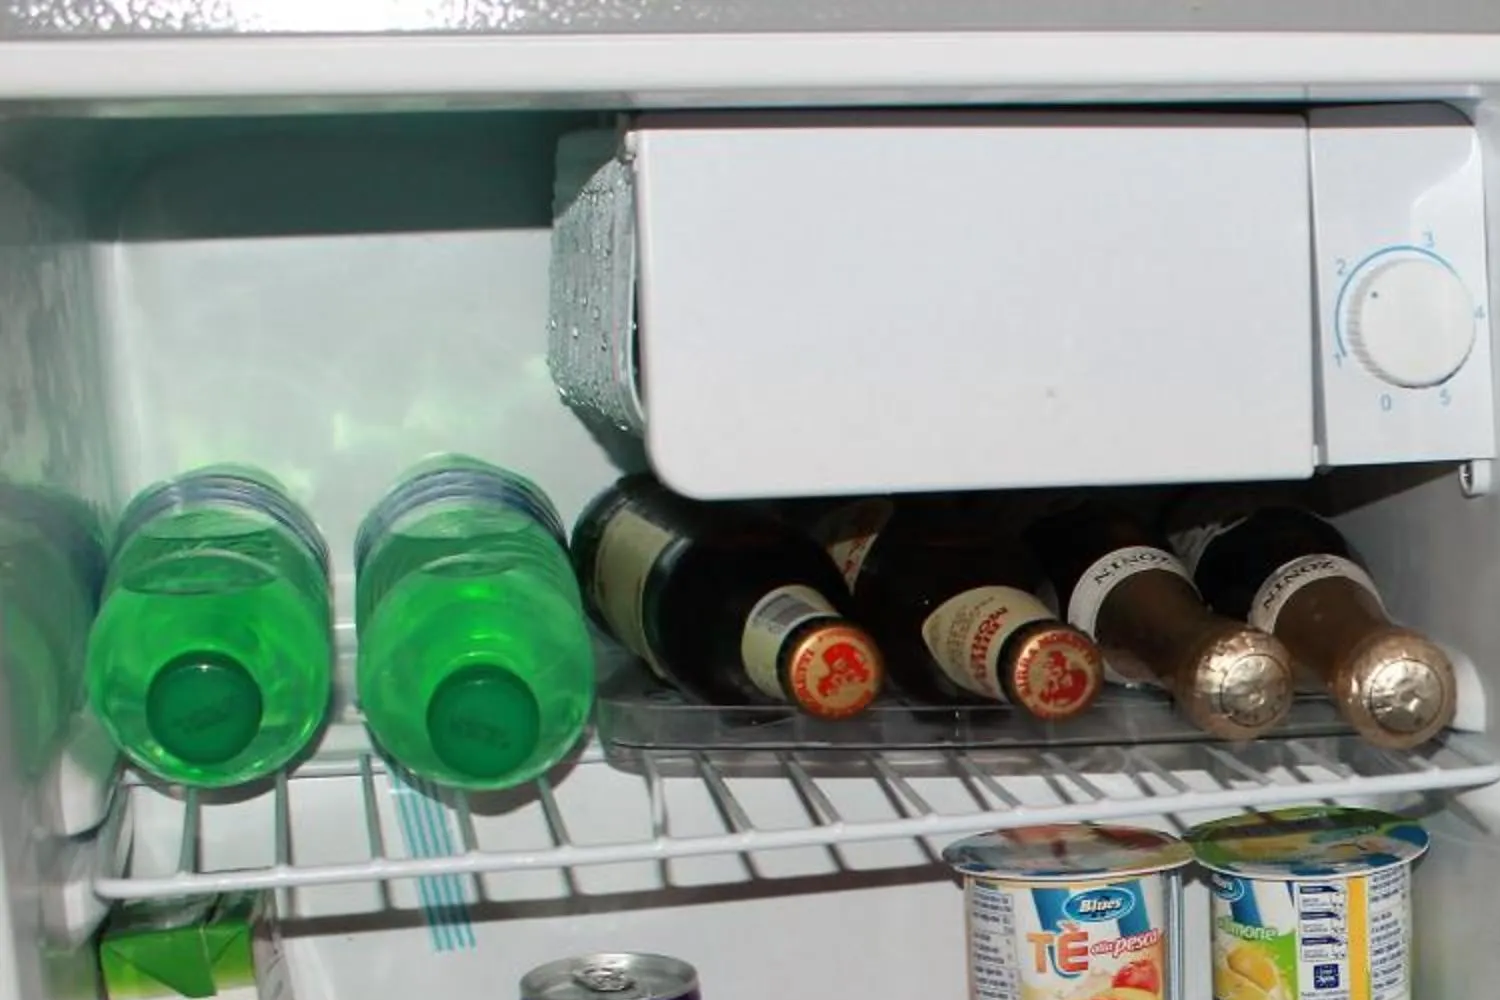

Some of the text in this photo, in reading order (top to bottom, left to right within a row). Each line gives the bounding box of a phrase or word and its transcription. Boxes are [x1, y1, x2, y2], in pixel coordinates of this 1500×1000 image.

[1336, 259, 1347, 276] 2
[1474, 306, 1486, 320] 4
[1381, 394, 1392, 412] 0
[1079, 898, 1123, 913] Blues
